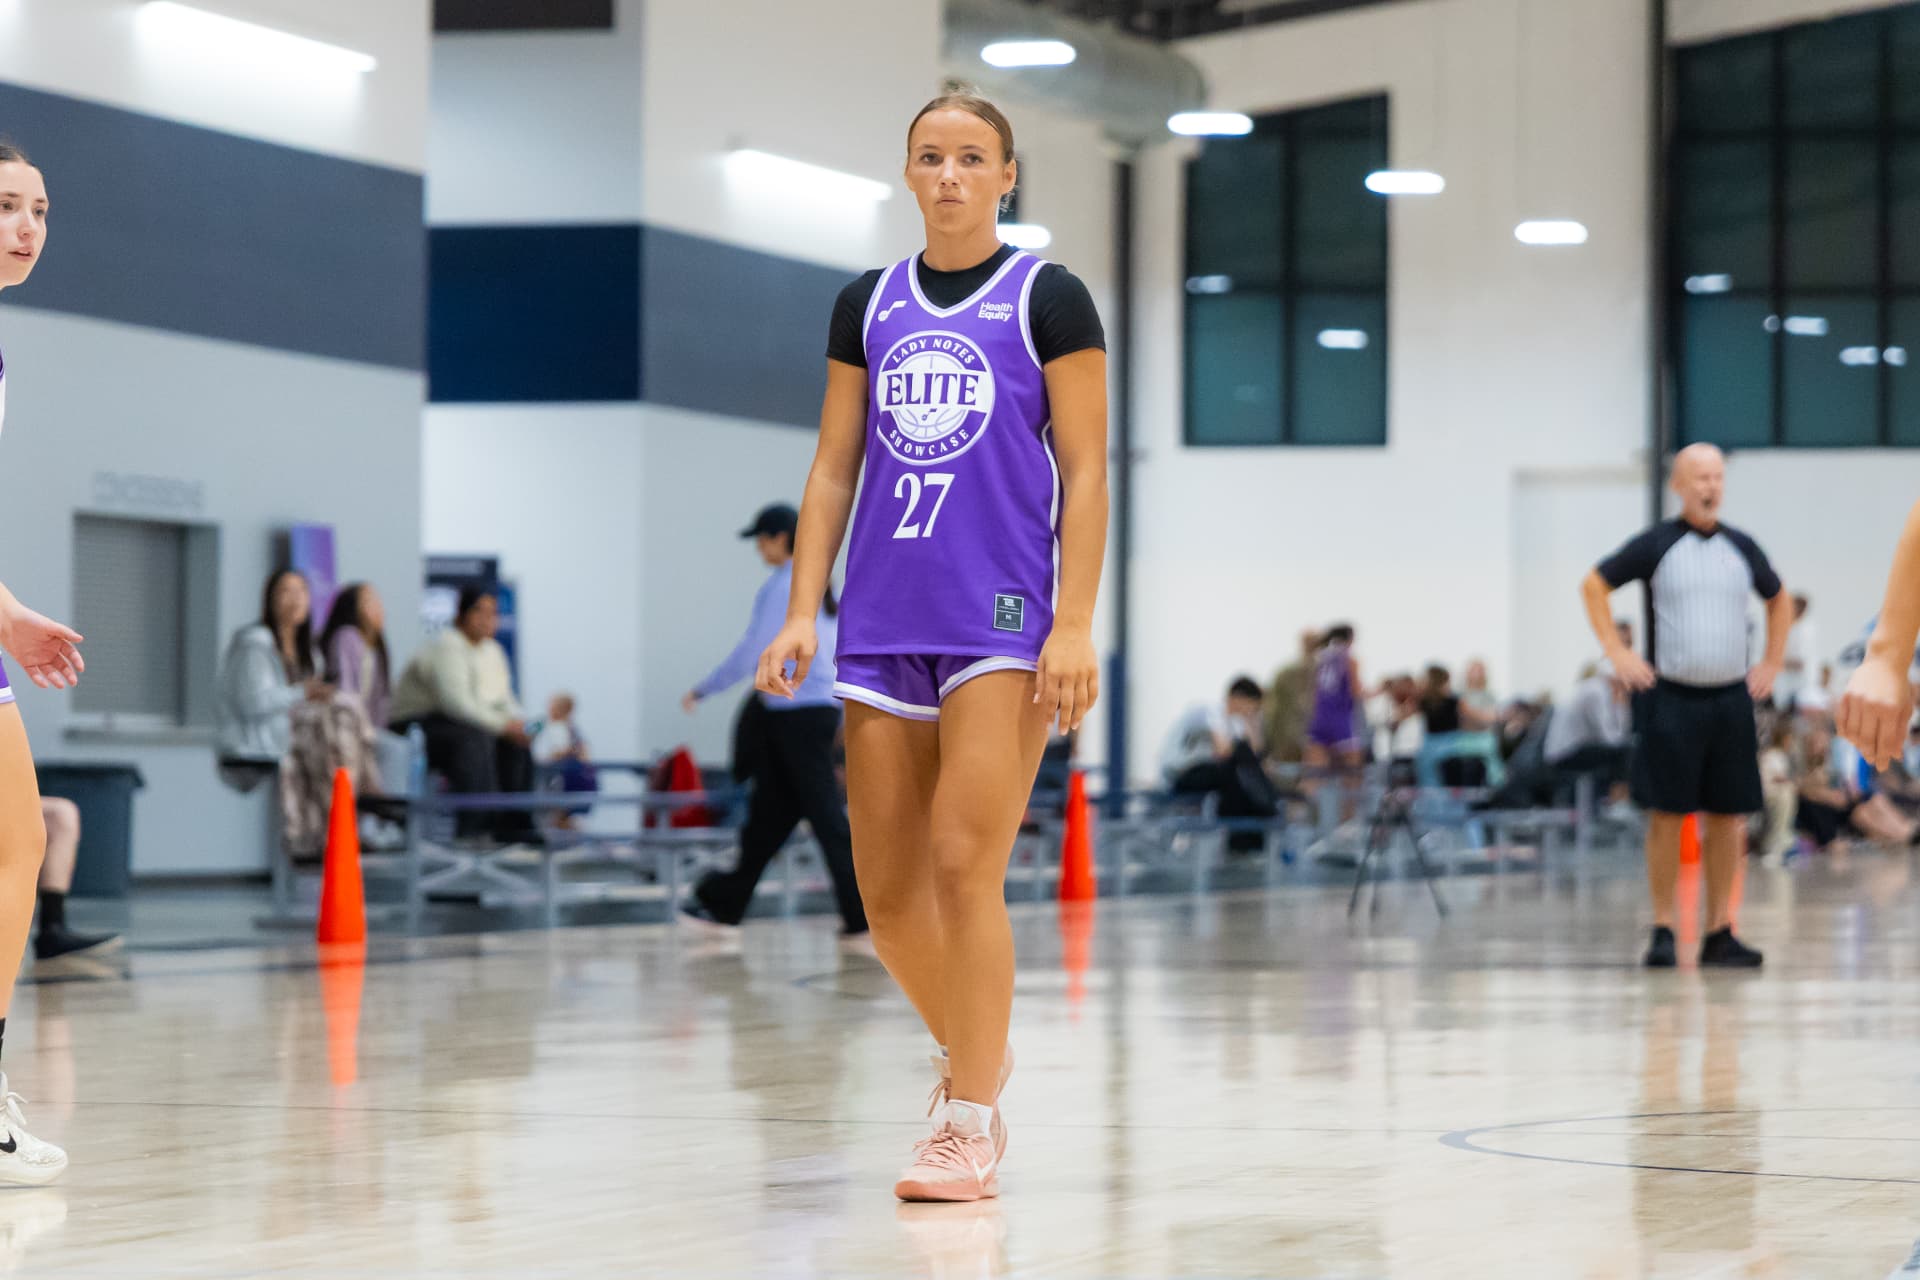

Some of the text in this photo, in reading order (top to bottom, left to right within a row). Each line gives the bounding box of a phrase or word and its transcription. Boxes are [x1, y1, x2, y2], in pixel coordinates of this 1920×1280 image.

[978, 309, 1013, 322] Equity
[979, 302, 1013, 312] Health
[892, 338, 976, 364] LADY NOTES
[884, 372, 979, 406] ELITE
[889, 429, 969, 457] SHOWCASE
[892, 473, 955, 539] 27
